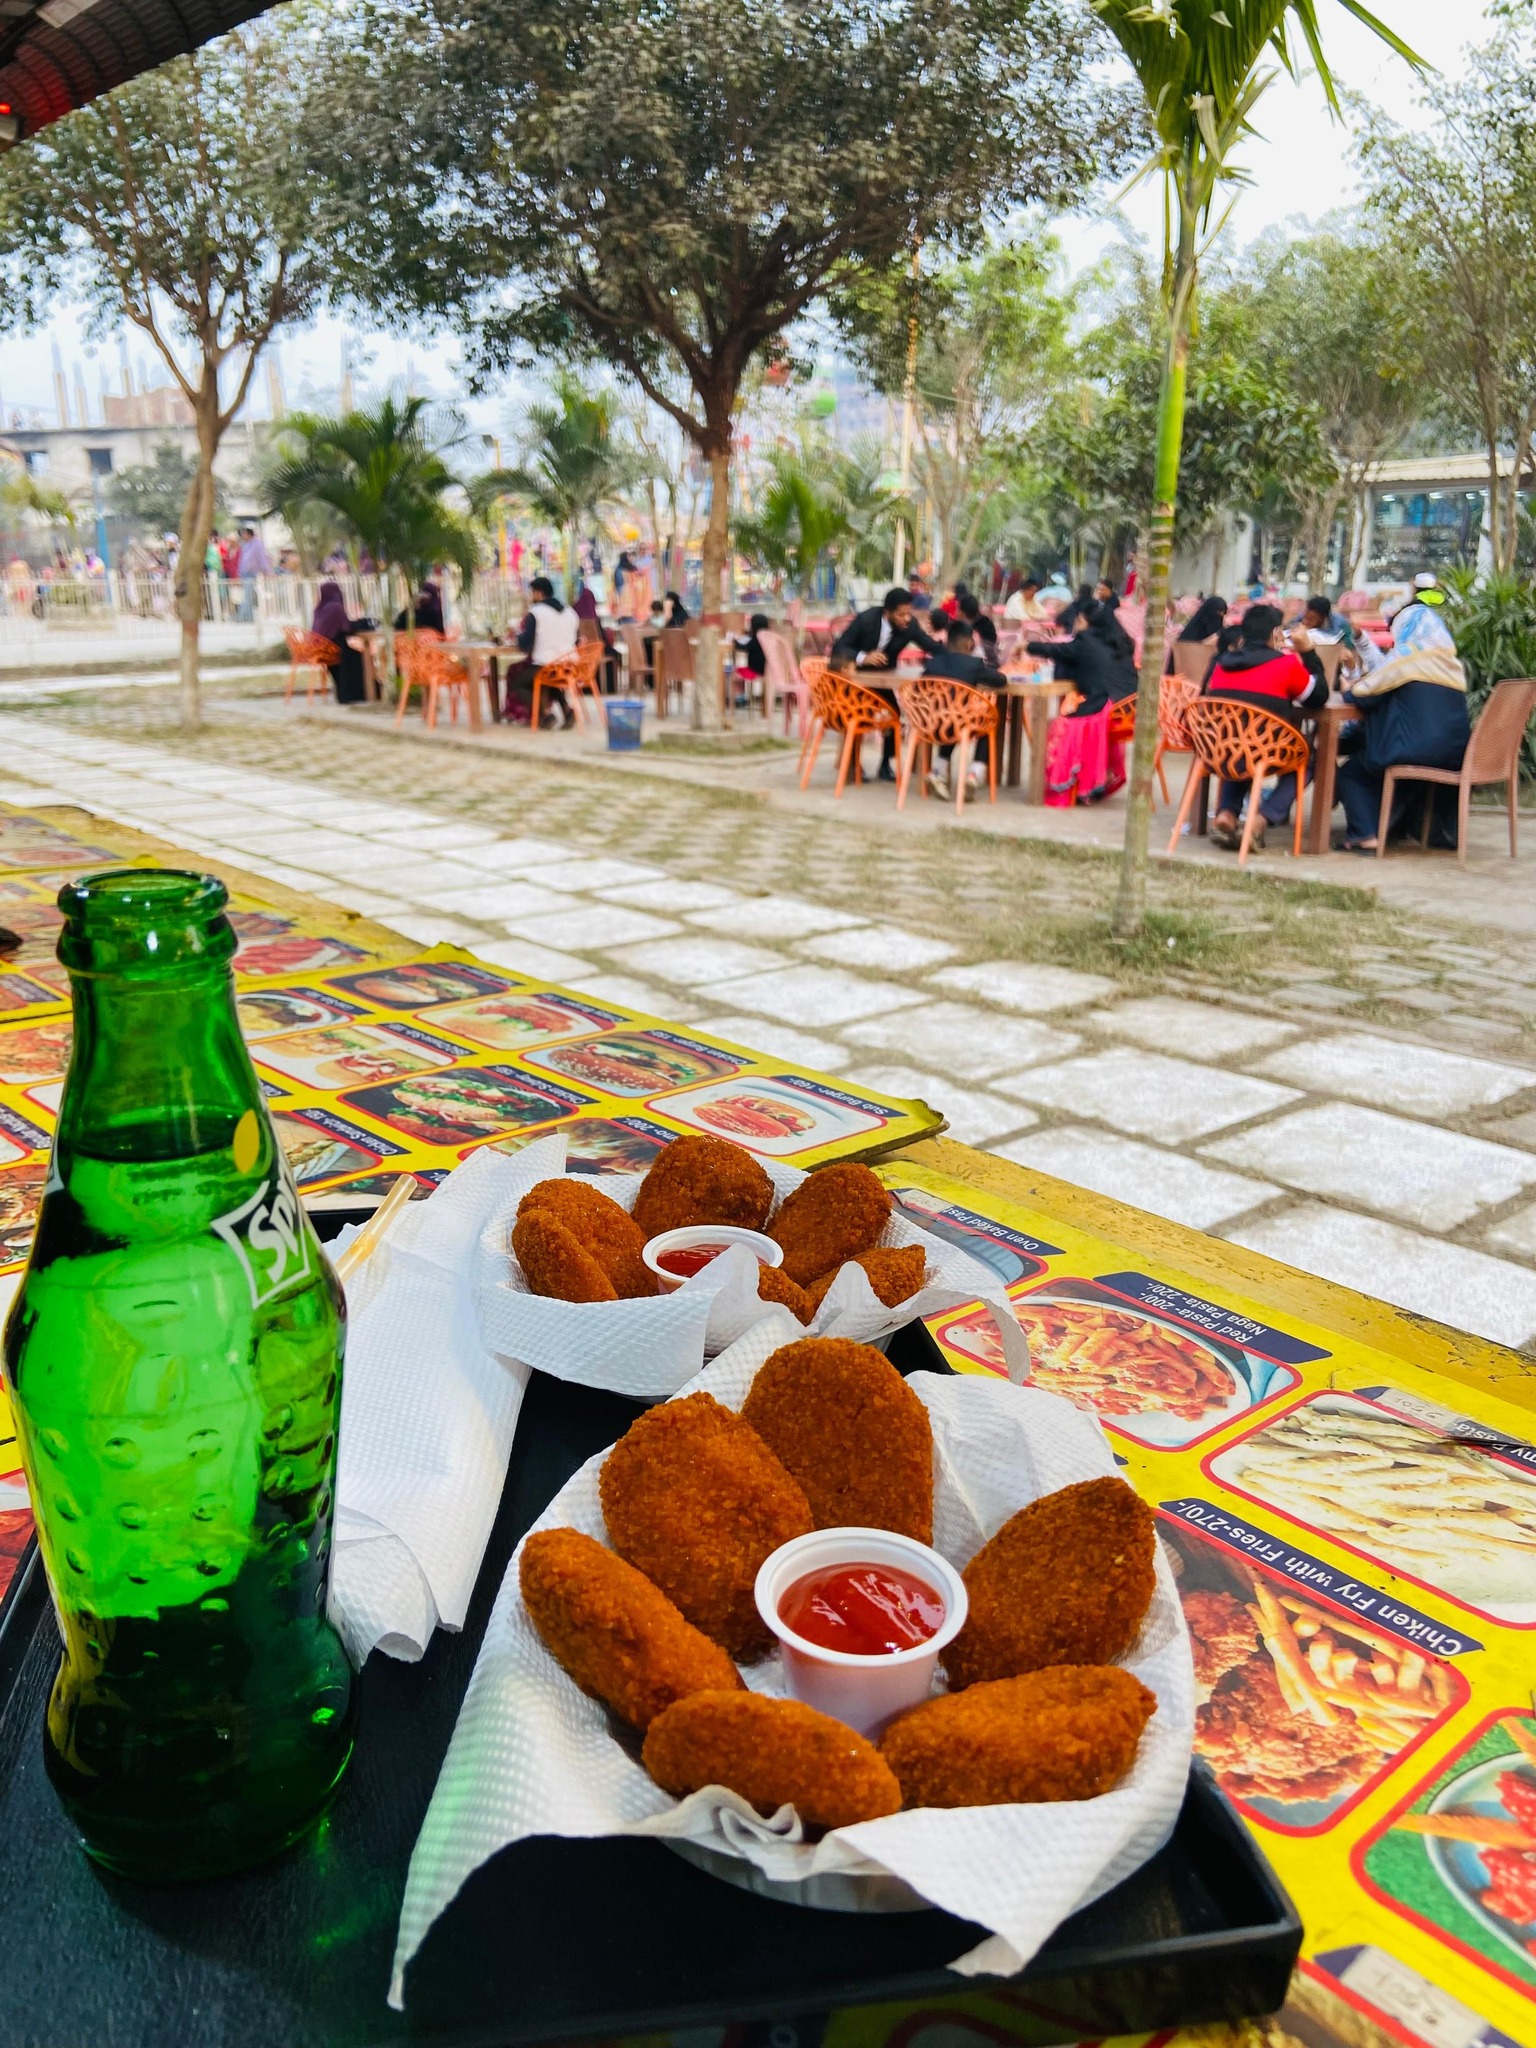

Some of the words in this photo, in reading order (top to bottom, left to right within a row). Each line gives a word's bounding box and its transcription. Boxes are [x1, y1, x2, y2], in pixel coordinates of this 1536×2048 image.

[788, 1077, 816, 1089] 160/-
[818, 1087, 861, 1105] Burger-
[862, 1102, 887, 1115] Sub
[360, 1135, 397, 1155] Chicken
[968, 1217, 1008, 1237] Baked
[1008, 1233, 1039, 1251] Oven
[1140, 1292, 1175, 1309] 200/-
[1148, 1282, 1182, 1299] 220/-
[1182, 1296, 1227, 1318] Pasta-
[1175, 1307, 1220, 1329] Pasta-
[1227, 1315, 1267, 1335] Naga
[1216, 1325, 1252, 1343] Red
[1178, 1501, 1284, 1559] Fries-270/-
[1282, 1556, 1333, 1585] with
[1333, 1584, 1376, 1608] Fry
[1377, 1604, 1462, 1653] Chiken
